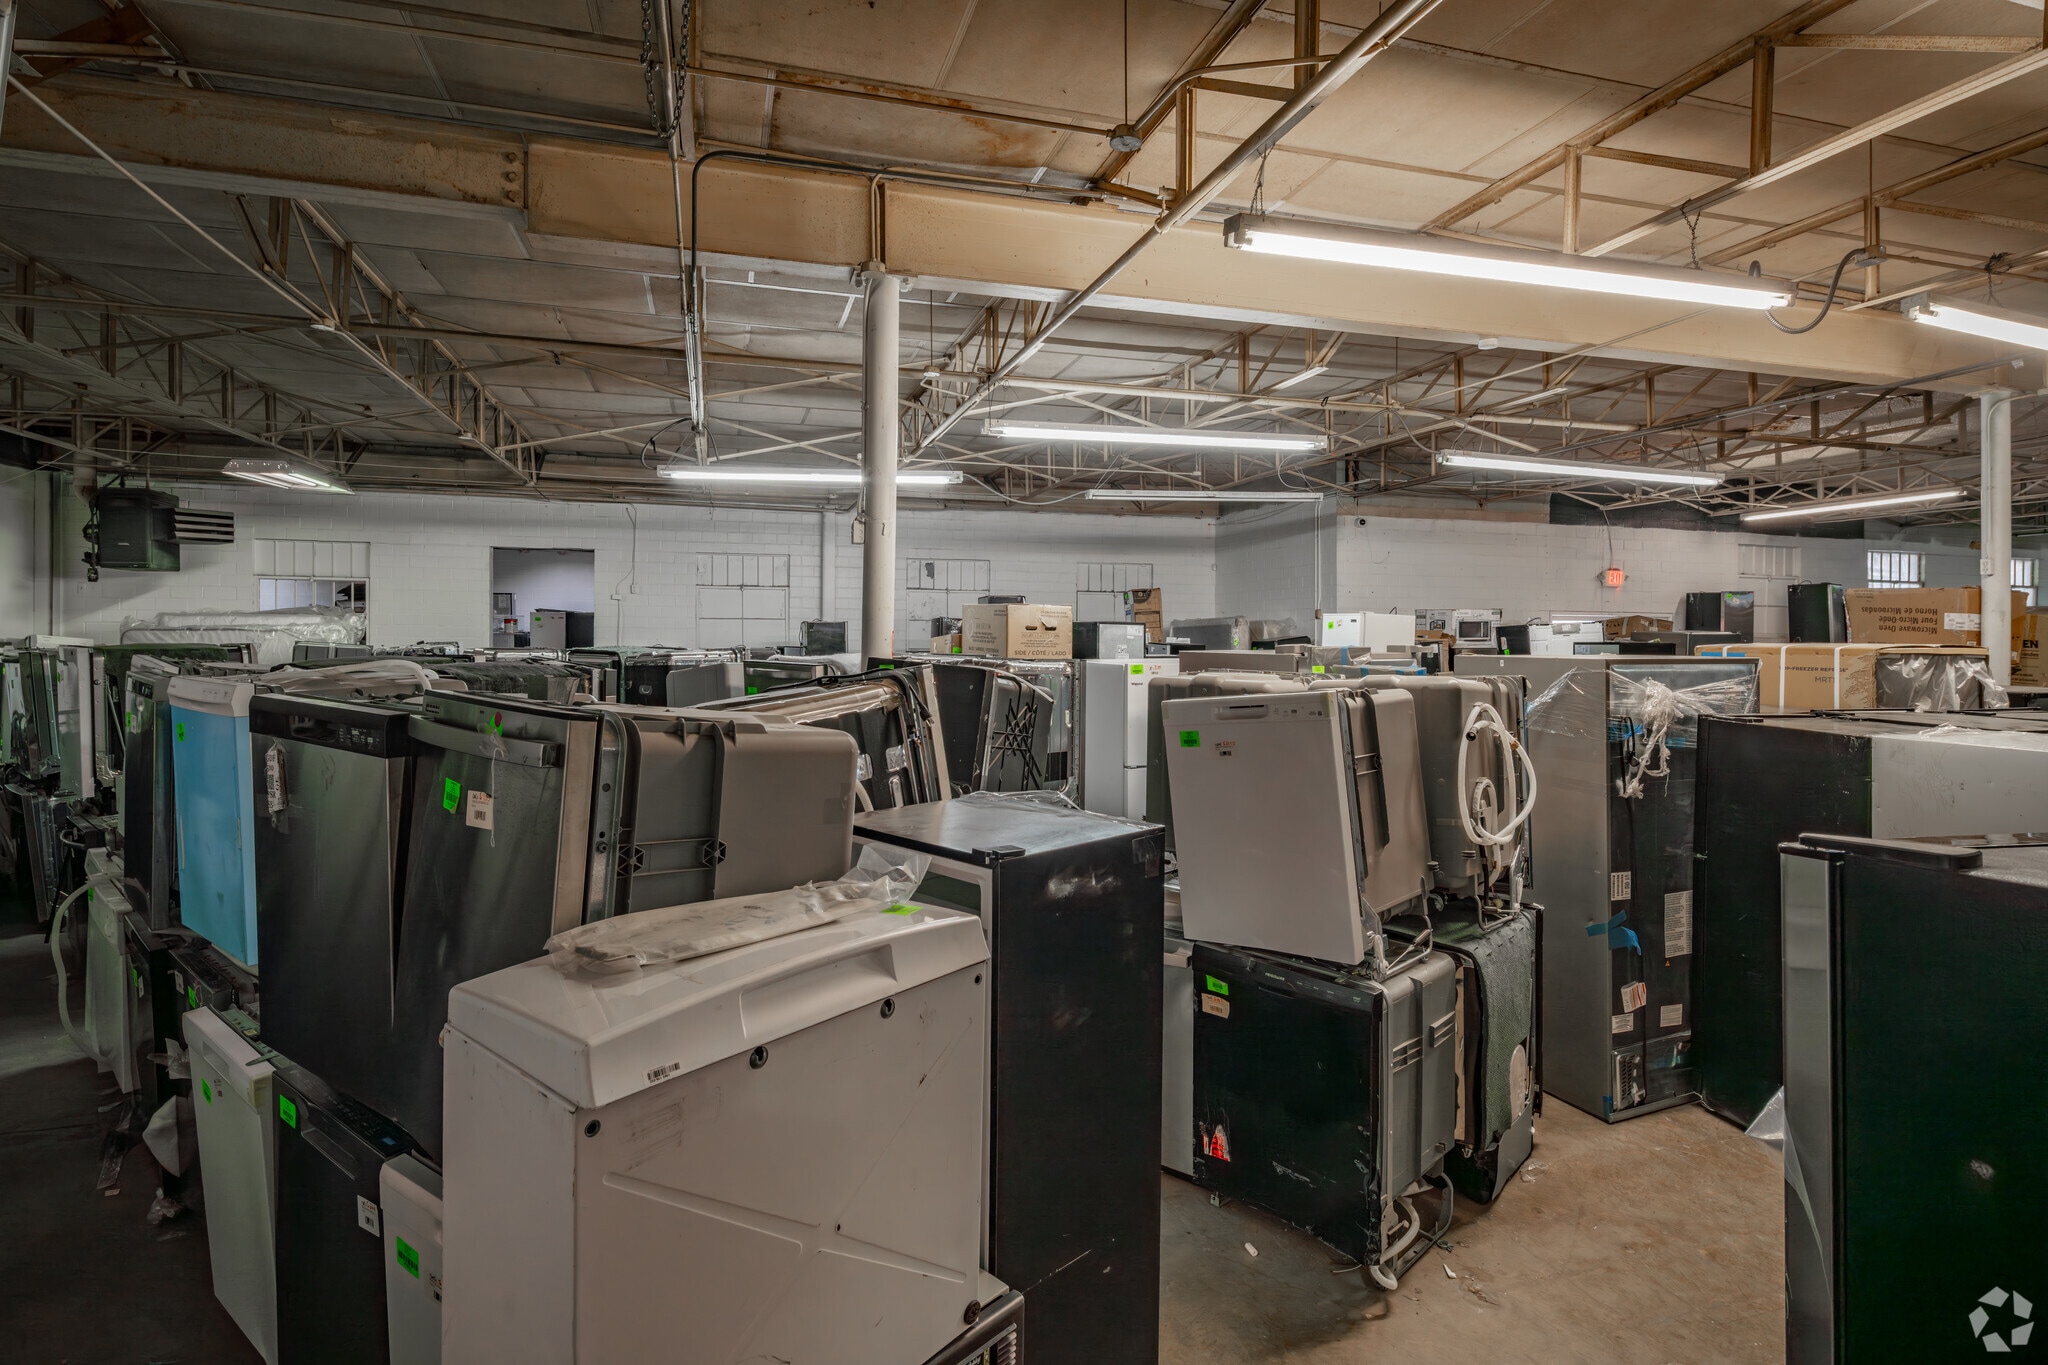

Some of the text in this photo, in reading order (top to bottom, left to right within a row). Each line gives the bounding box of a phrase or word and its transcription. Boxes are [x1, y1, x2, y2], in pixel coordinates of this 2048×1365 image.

[1609, 570, 1623, 585] EXIT
[1861, 606, 1902, 615] Microondas
[1915, 607, 1938, 615] Horno
[1879, 615, 1919, 624] Micro-Onde
[1921, 617, 1938, 625] Four
[1898, 625, 1938, 635] Microwave
[2023, 639, 2038, 649] EN
